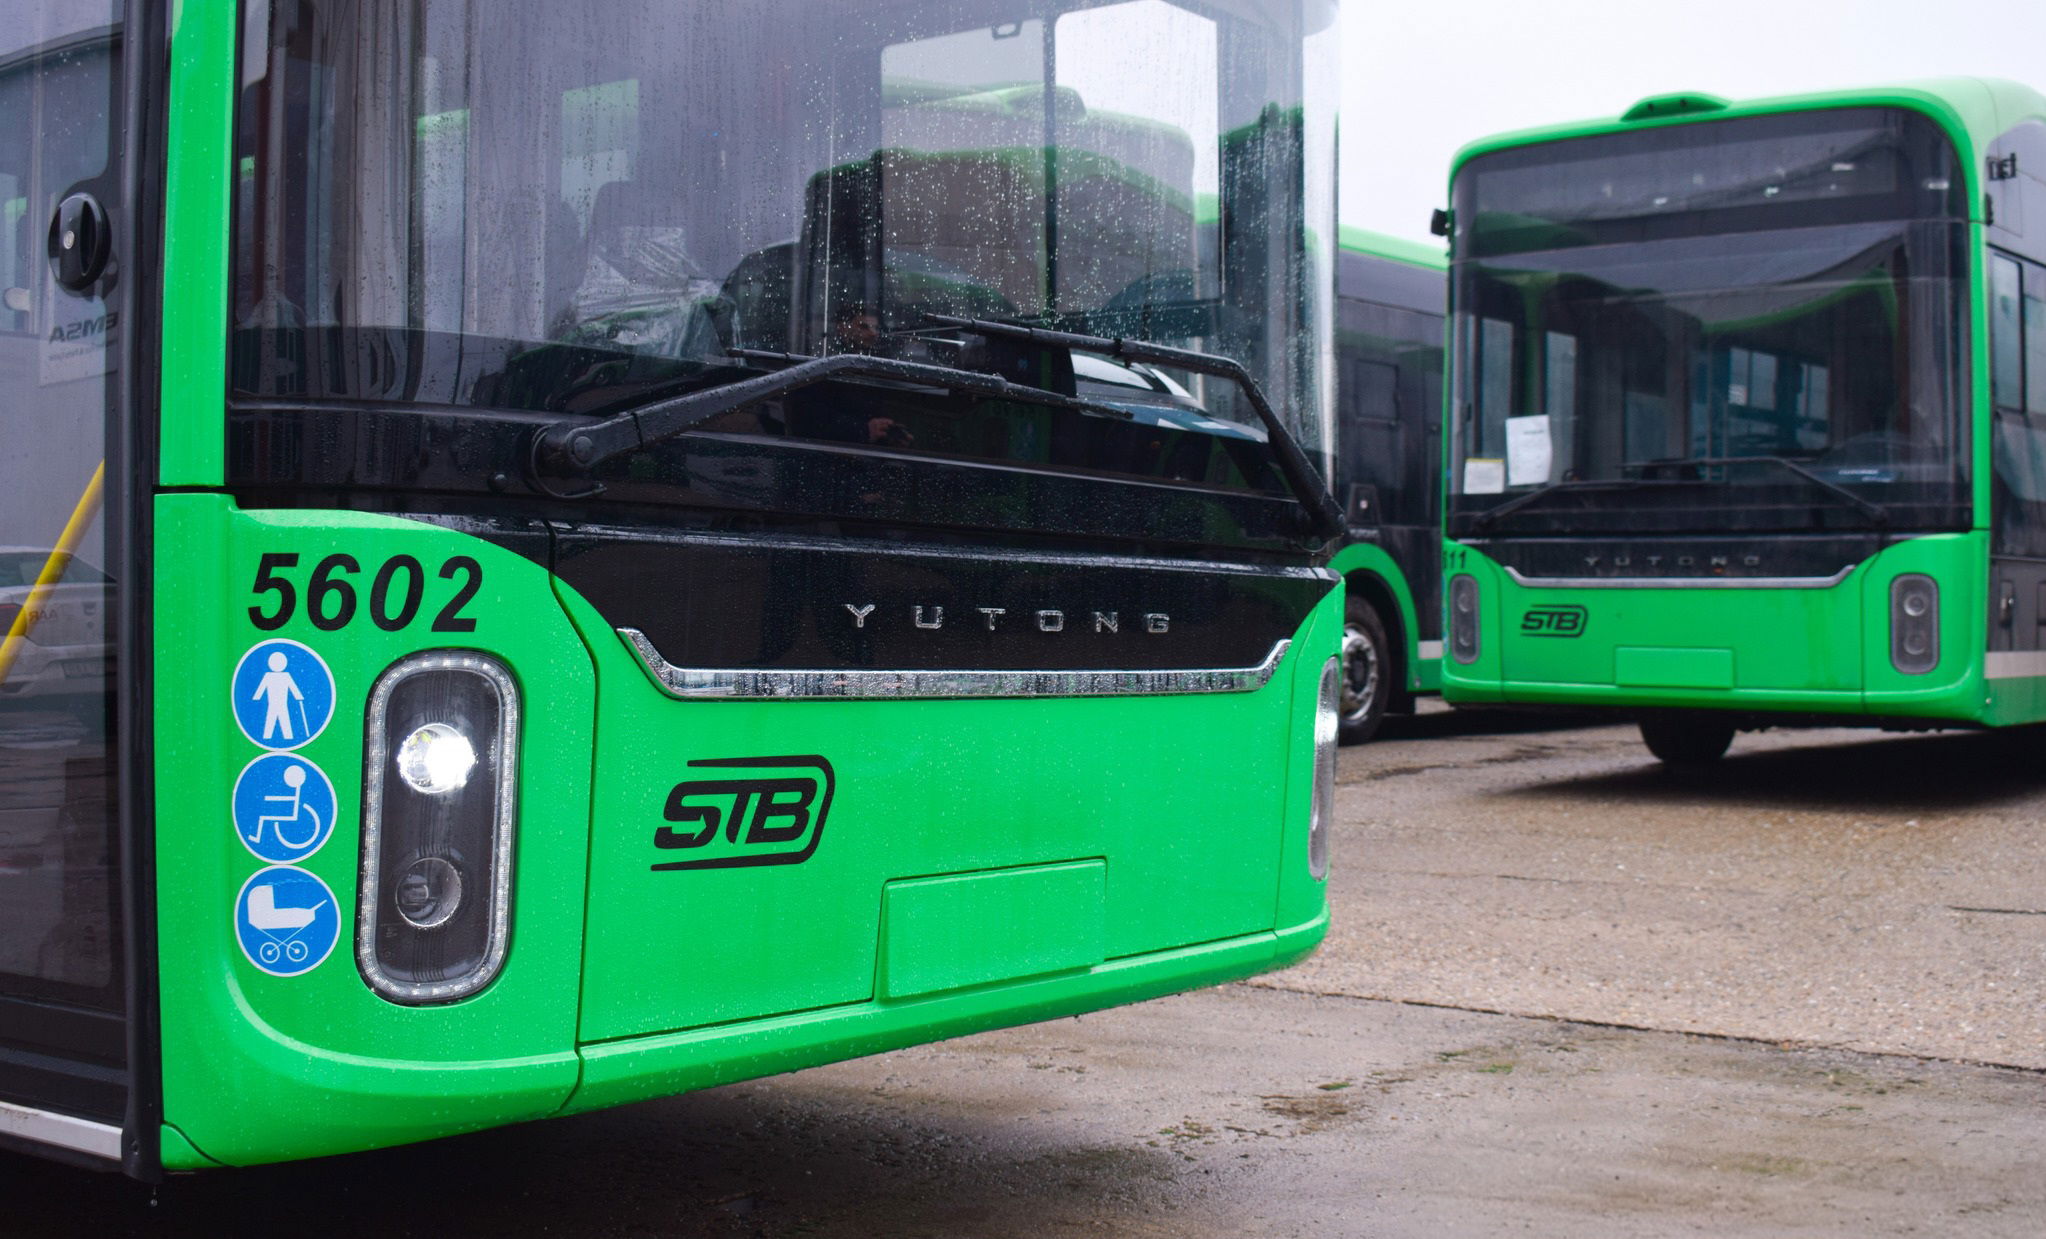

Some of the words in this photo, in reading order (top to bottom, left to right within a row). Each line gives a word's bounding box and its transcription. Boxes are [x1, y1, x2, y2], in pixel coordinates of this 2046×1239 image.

[1584, 555, 1760, 567] YUTONG
[247, 552, 484, 633] 5602
[845, 603, 1170, 634] YUTONG
[1521, 611, 1581, 631] STB
[653, 777, 818, 850] STB
